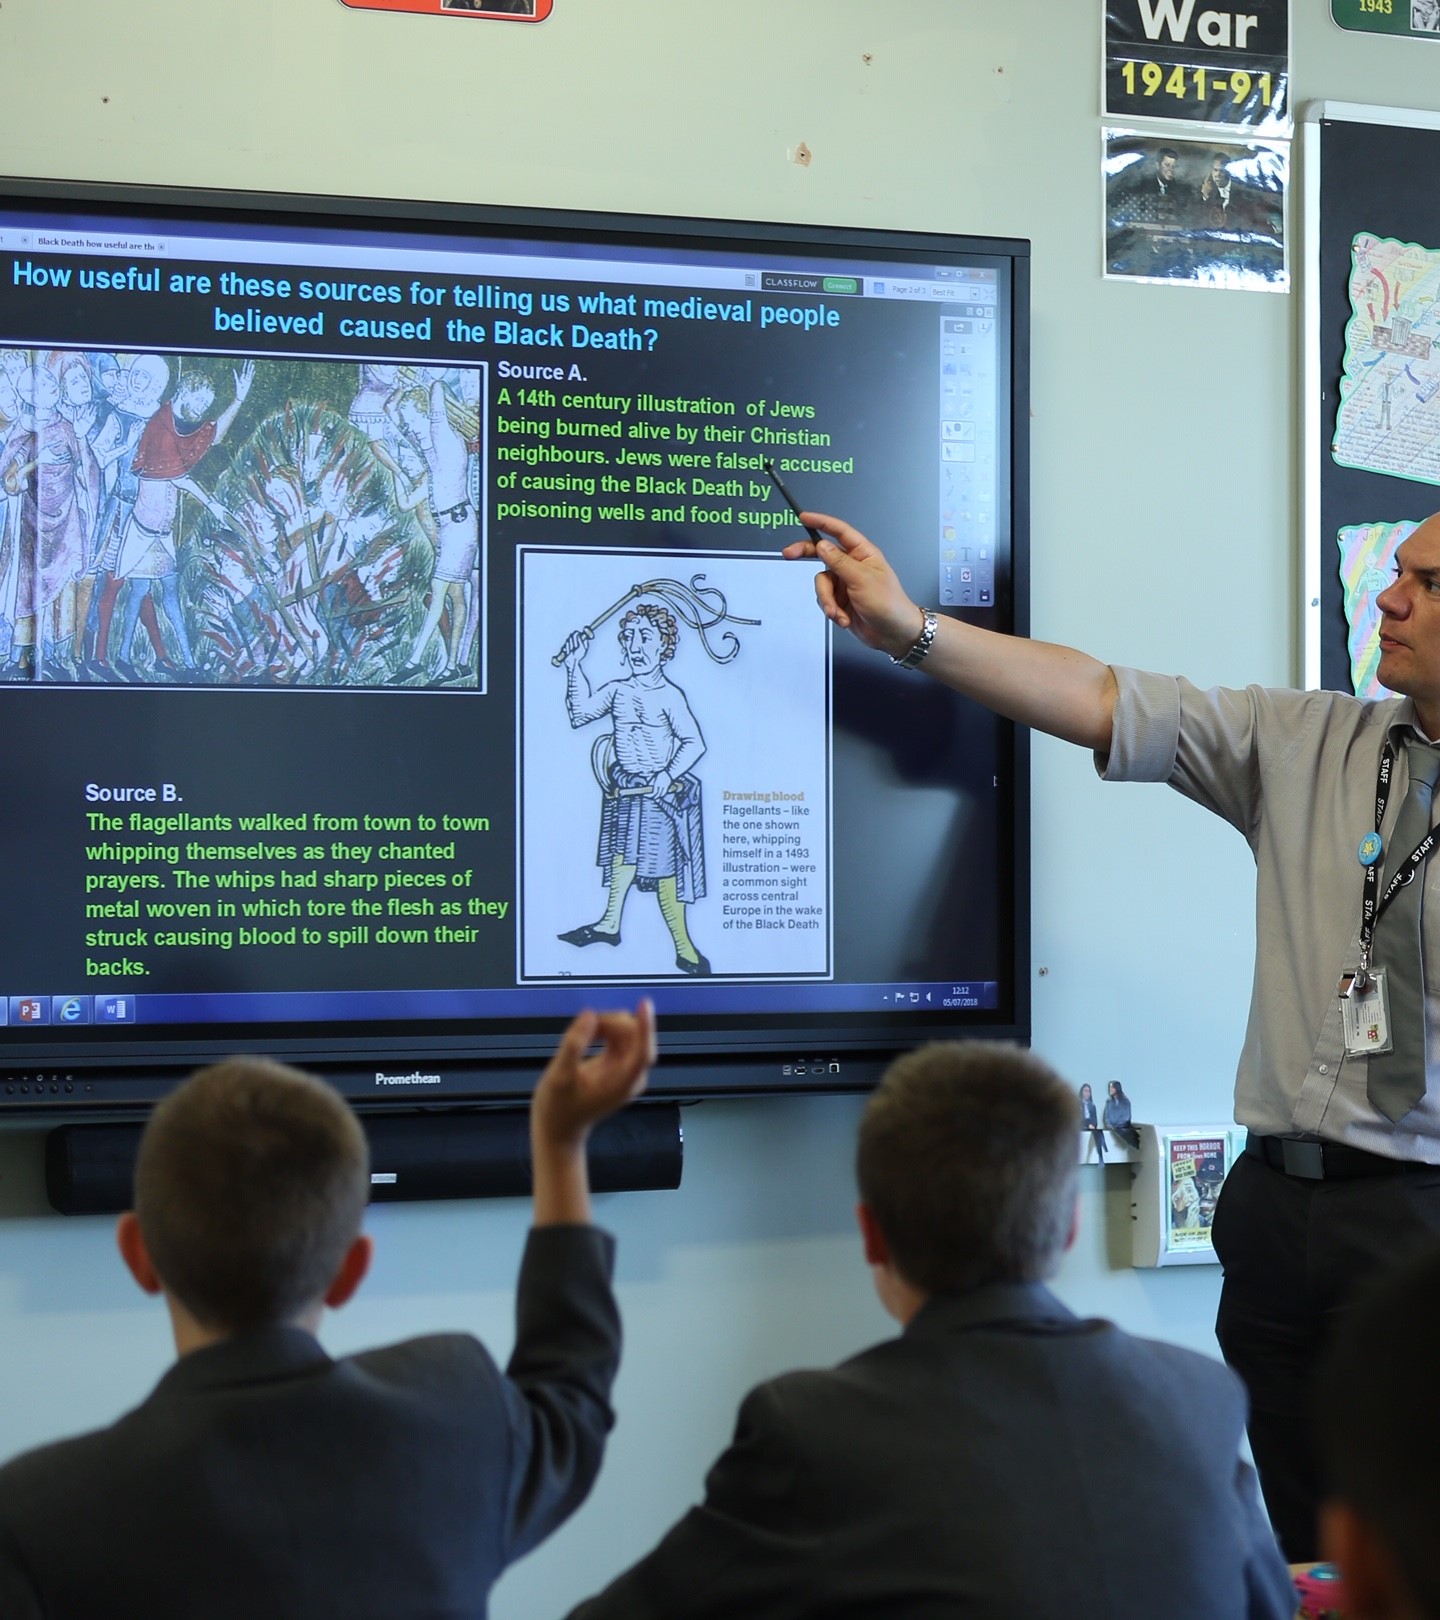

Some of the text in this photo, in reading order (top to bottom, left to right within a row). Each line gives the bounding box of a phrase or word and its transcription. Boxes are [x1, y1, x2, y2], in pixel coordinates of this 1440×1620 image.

[1359, 0, 1393, 15] 1943
[1138, 0, 1258, 48] War
[1122, 61, 1271, 106] 1941-91
[38, 238, 59, 246] Black
[61, 239, 84, 248] Death
[765, 278, 817, 288] CLASSFLOW
[14, 261, 841, 331] How useful are these sources for telling us what medieval people
[216, 306, 659, 352] believed caused the Black Death?
[497, 360, 588, 382] Source A.
[497, 387, 815, 419] A 14th century illustration of Jews
[498, 415, 832, 447] being burned alive by their Christian
[1380, 758, 1389, 784] STAFF
[85, 783, 183, 802] Source B.
[723, 791, 804, 802] Drawing blood
[723, 805, 810, 817] Flagellants like
[1376, 798, 1384, 824] STAFF
[85, 812, 490, 836] The flagellants walked from town to town
[1411, 836, 1434, 862] STAFF
[1384, 873, 1402, 899] STAFF
[943, 998, 977, 1006] 05/07/2018
[375, 1072, 440, 1085] Promethean
